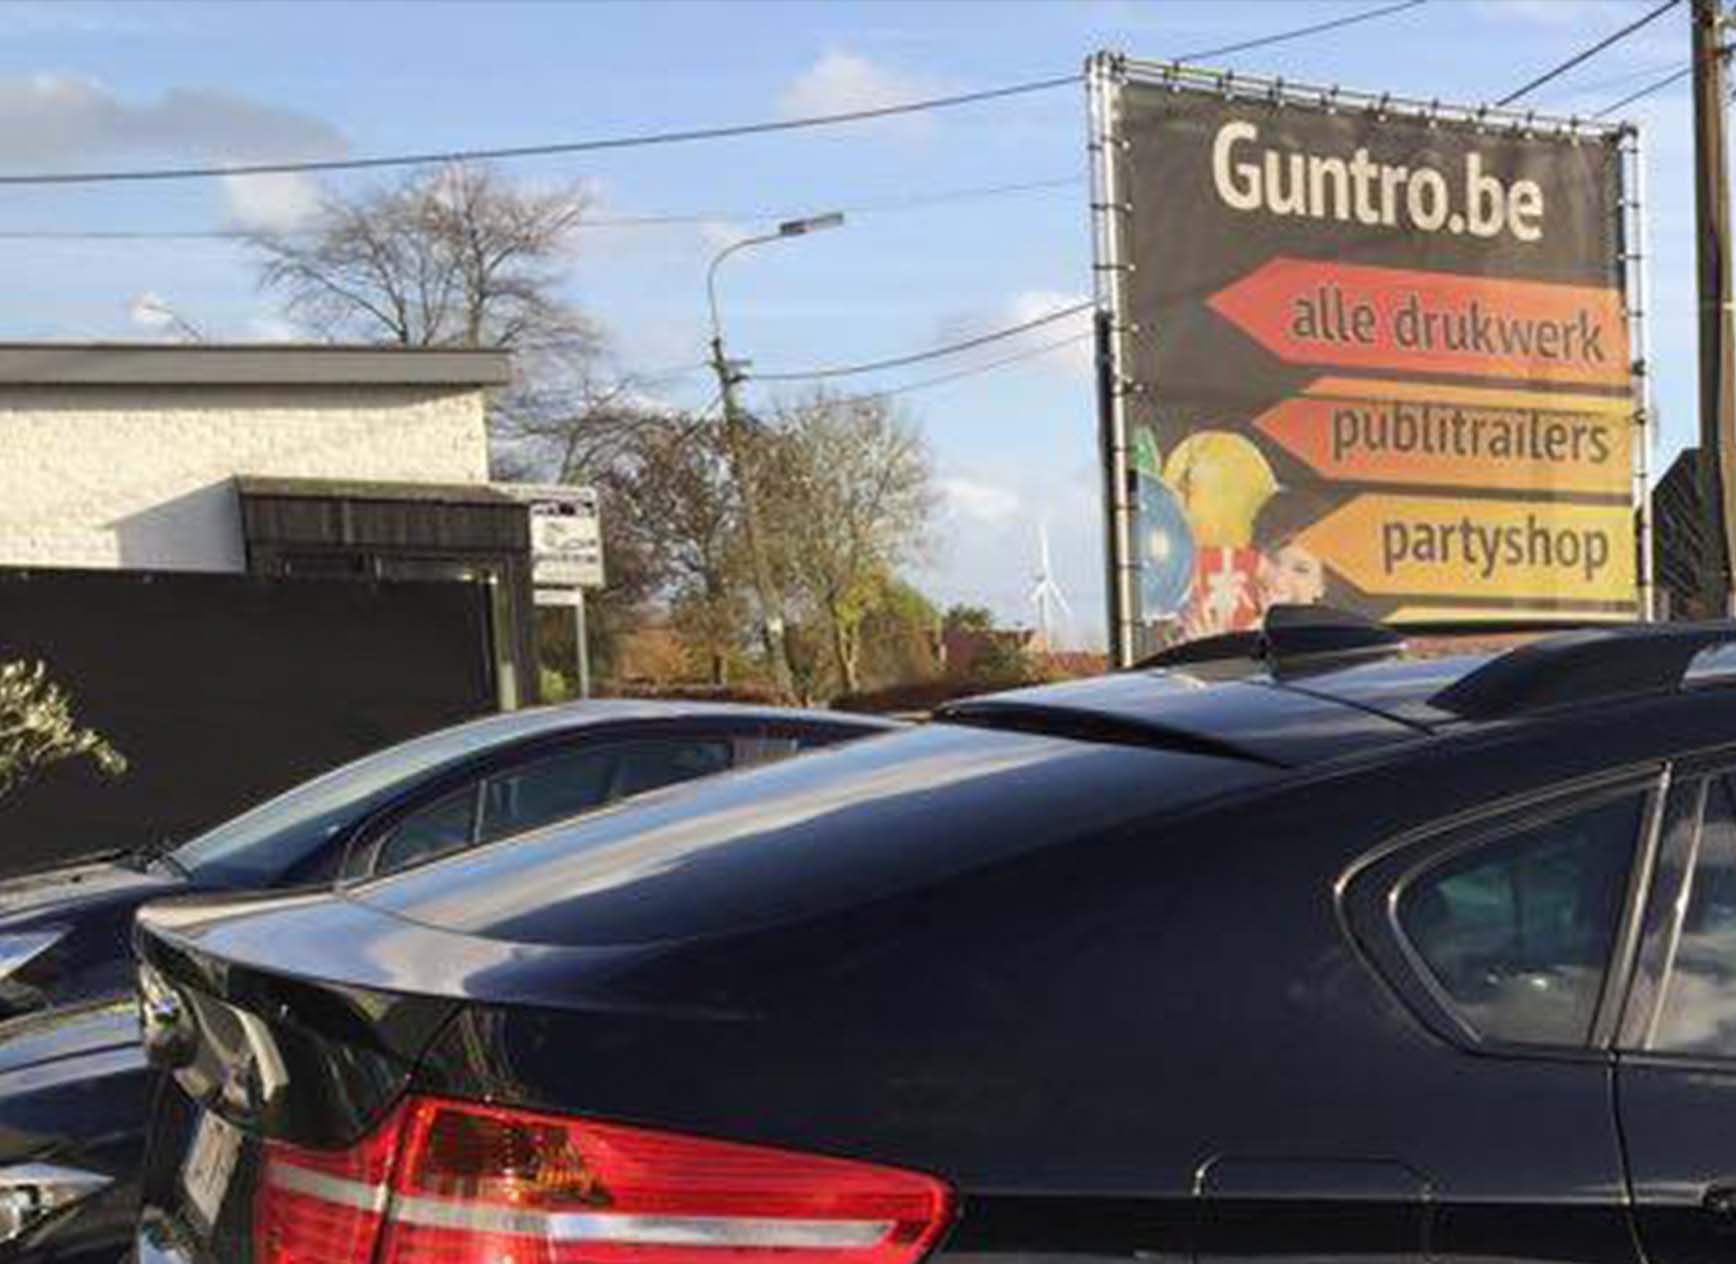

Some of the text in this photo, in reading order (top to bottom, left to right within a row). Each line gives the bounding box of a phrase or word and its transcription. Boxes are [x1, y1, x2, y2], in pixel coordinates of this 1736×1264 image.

[1212, 121, 1545, 242] Guntro.be
[1291, 285, 1605, 362] alle drukwerk
[1332, 402, 1610, 464] publitrailers
[1382, 512, 1609, 579] partyshop
